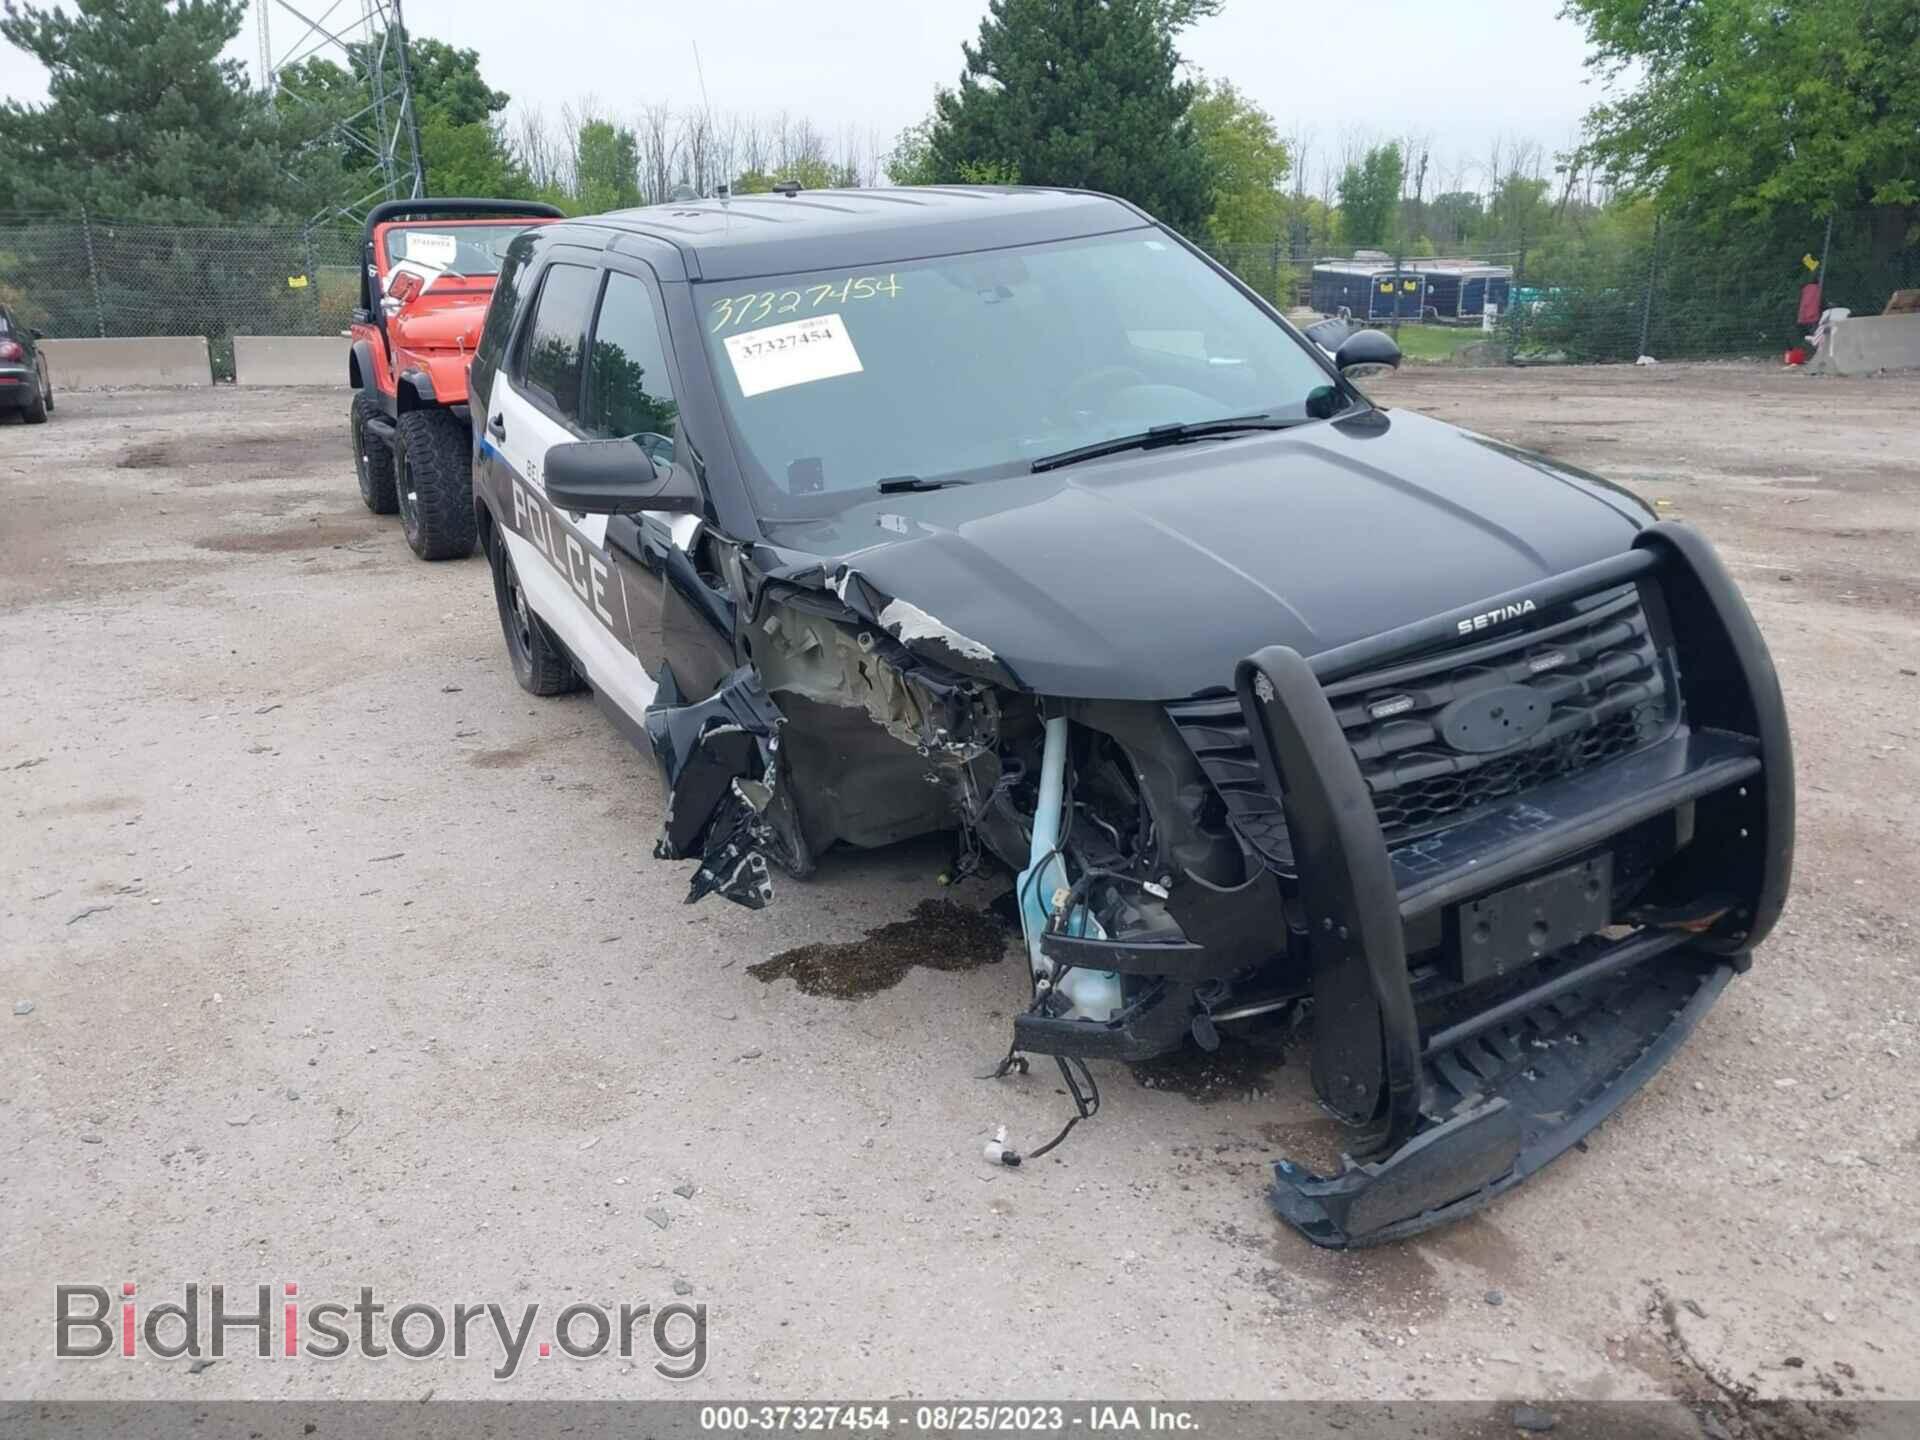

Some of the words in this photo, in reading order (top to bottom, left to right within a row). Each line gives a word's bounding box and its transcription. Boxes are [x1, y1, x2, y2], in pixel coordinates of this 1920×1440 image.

[711, 273, 905, 333] 37327454
[743, 328, 833, 359] 37327454
[1457, 599, 1537, 635] SETINA
